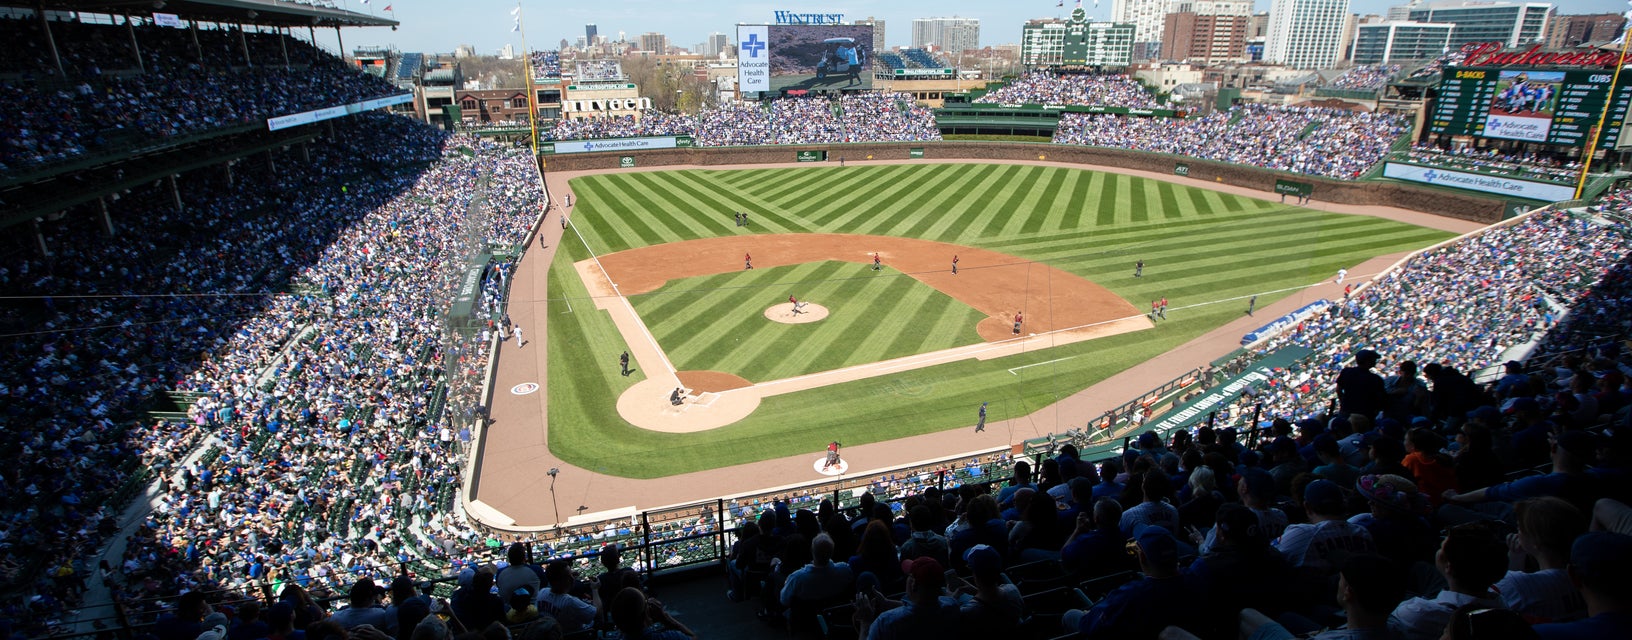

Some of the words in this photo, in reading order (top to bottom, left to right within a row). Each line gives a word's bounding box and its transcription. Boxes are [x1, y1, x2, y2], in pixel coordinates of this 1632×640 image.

[774, 10, 844, 24] WINTRUST
[1588, 74, 1612, 83] CUBS
[562, 97, 651, 112] nuveen
[1501, 121, 1538, 130] Advocate
[1499, 129, 1525, 137] Health
[1526, 131, 1545, 139] Care
[1438, 173, 1474, 184] Advocate
[1473, 177, 1501, 188] Health
[1502, 181, 1523, 191] Care
